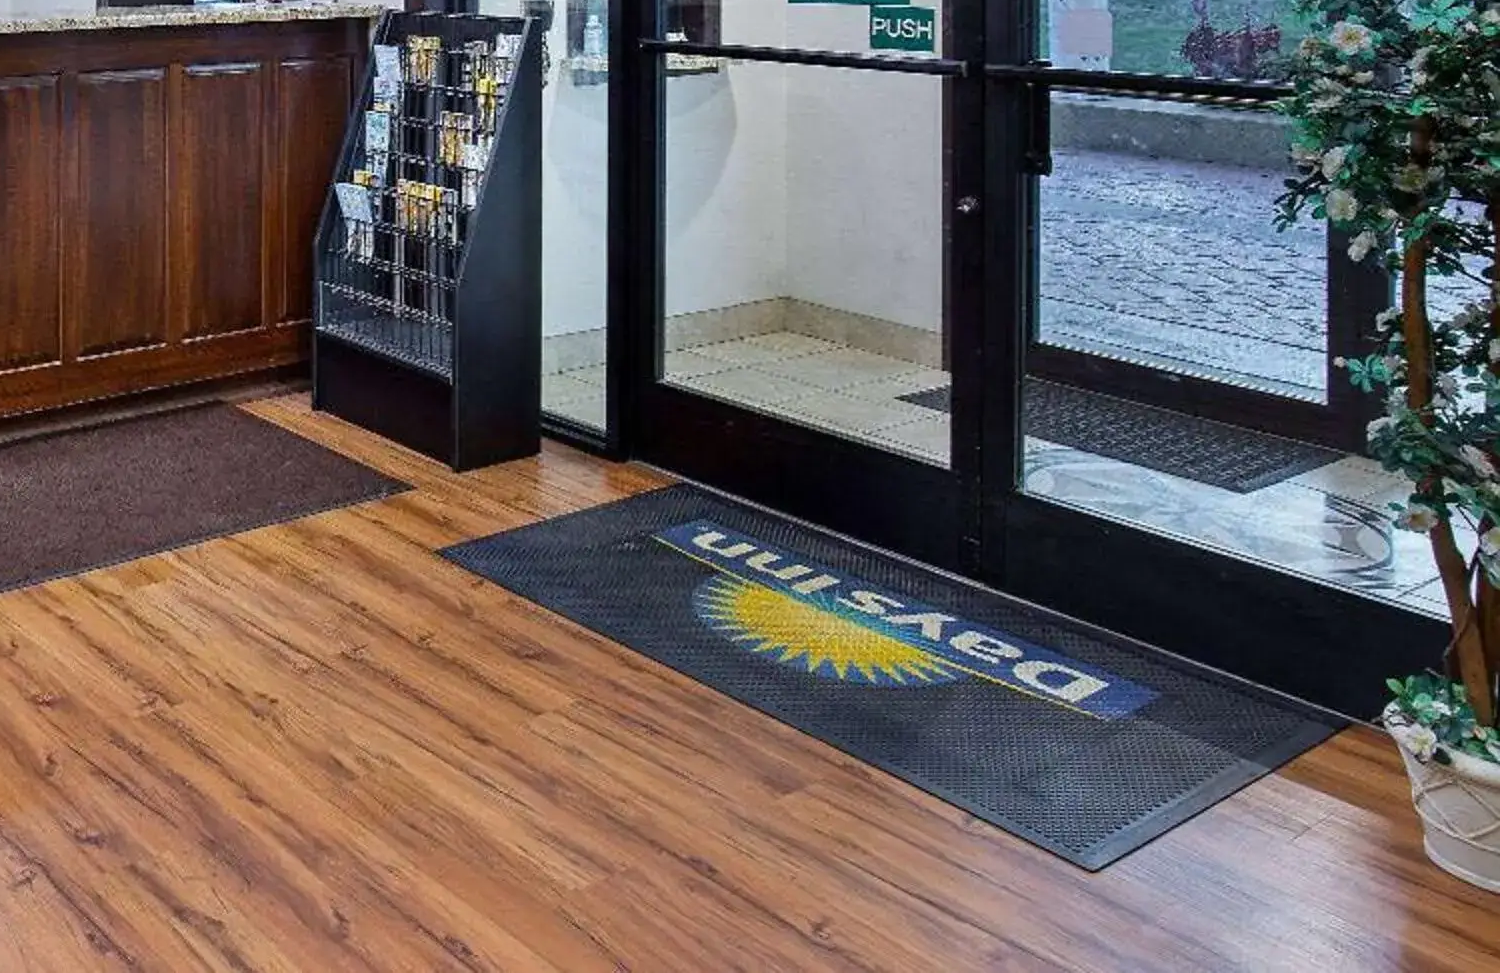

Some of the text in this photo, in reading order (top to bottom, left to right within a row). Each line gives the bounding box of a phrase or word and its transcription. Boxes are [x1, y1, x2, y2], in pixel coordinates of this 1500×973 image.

[871, 16, 933, 40] PUSH
[691, 526, 1109, 703] Days Inn
